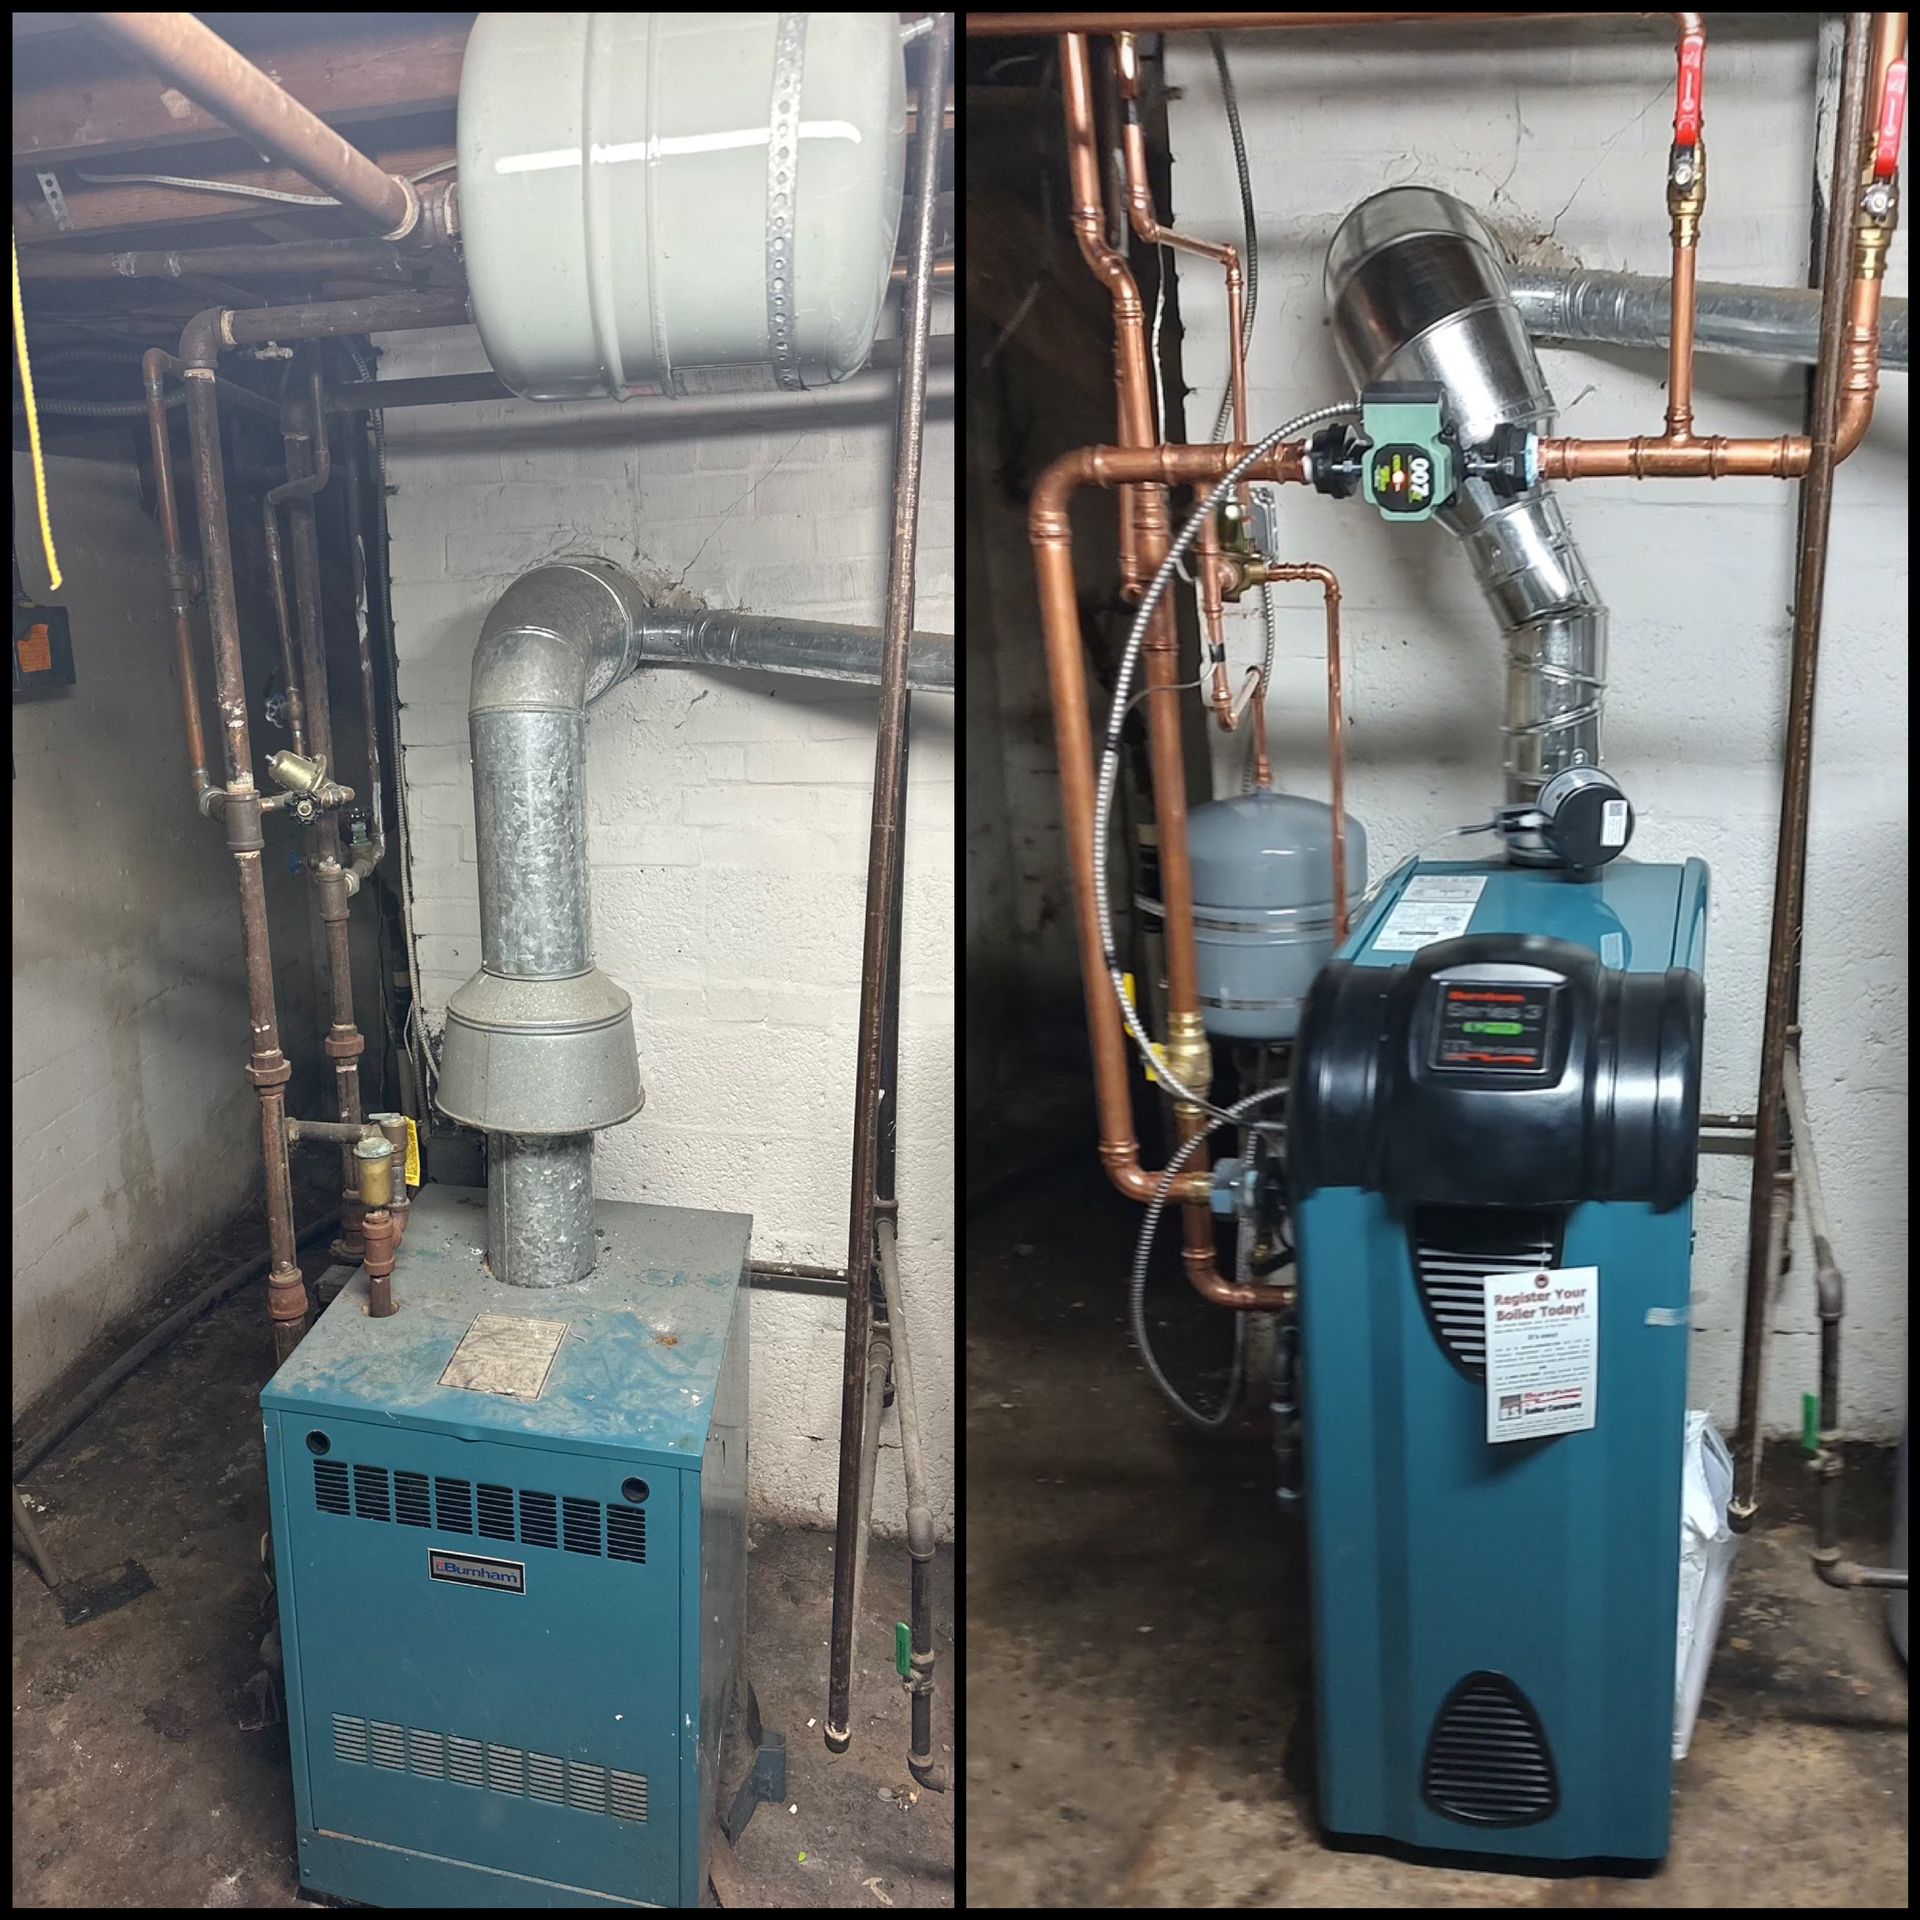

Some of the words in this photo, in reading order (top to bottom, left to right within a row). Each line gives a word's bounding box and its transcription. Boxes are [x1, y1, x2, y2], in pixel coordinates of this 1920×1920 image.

[1523, 1004, 1542, 1019] 3
[1494, 1292, 1551, 1306] Register
[1555, 1288, 1587, 1300] Your
[1496, 1308, 1536, 1322] Boiler
[1539, 1302, 1585, 1317] Today!
[445, 1562, 517, 1583] Burnham
